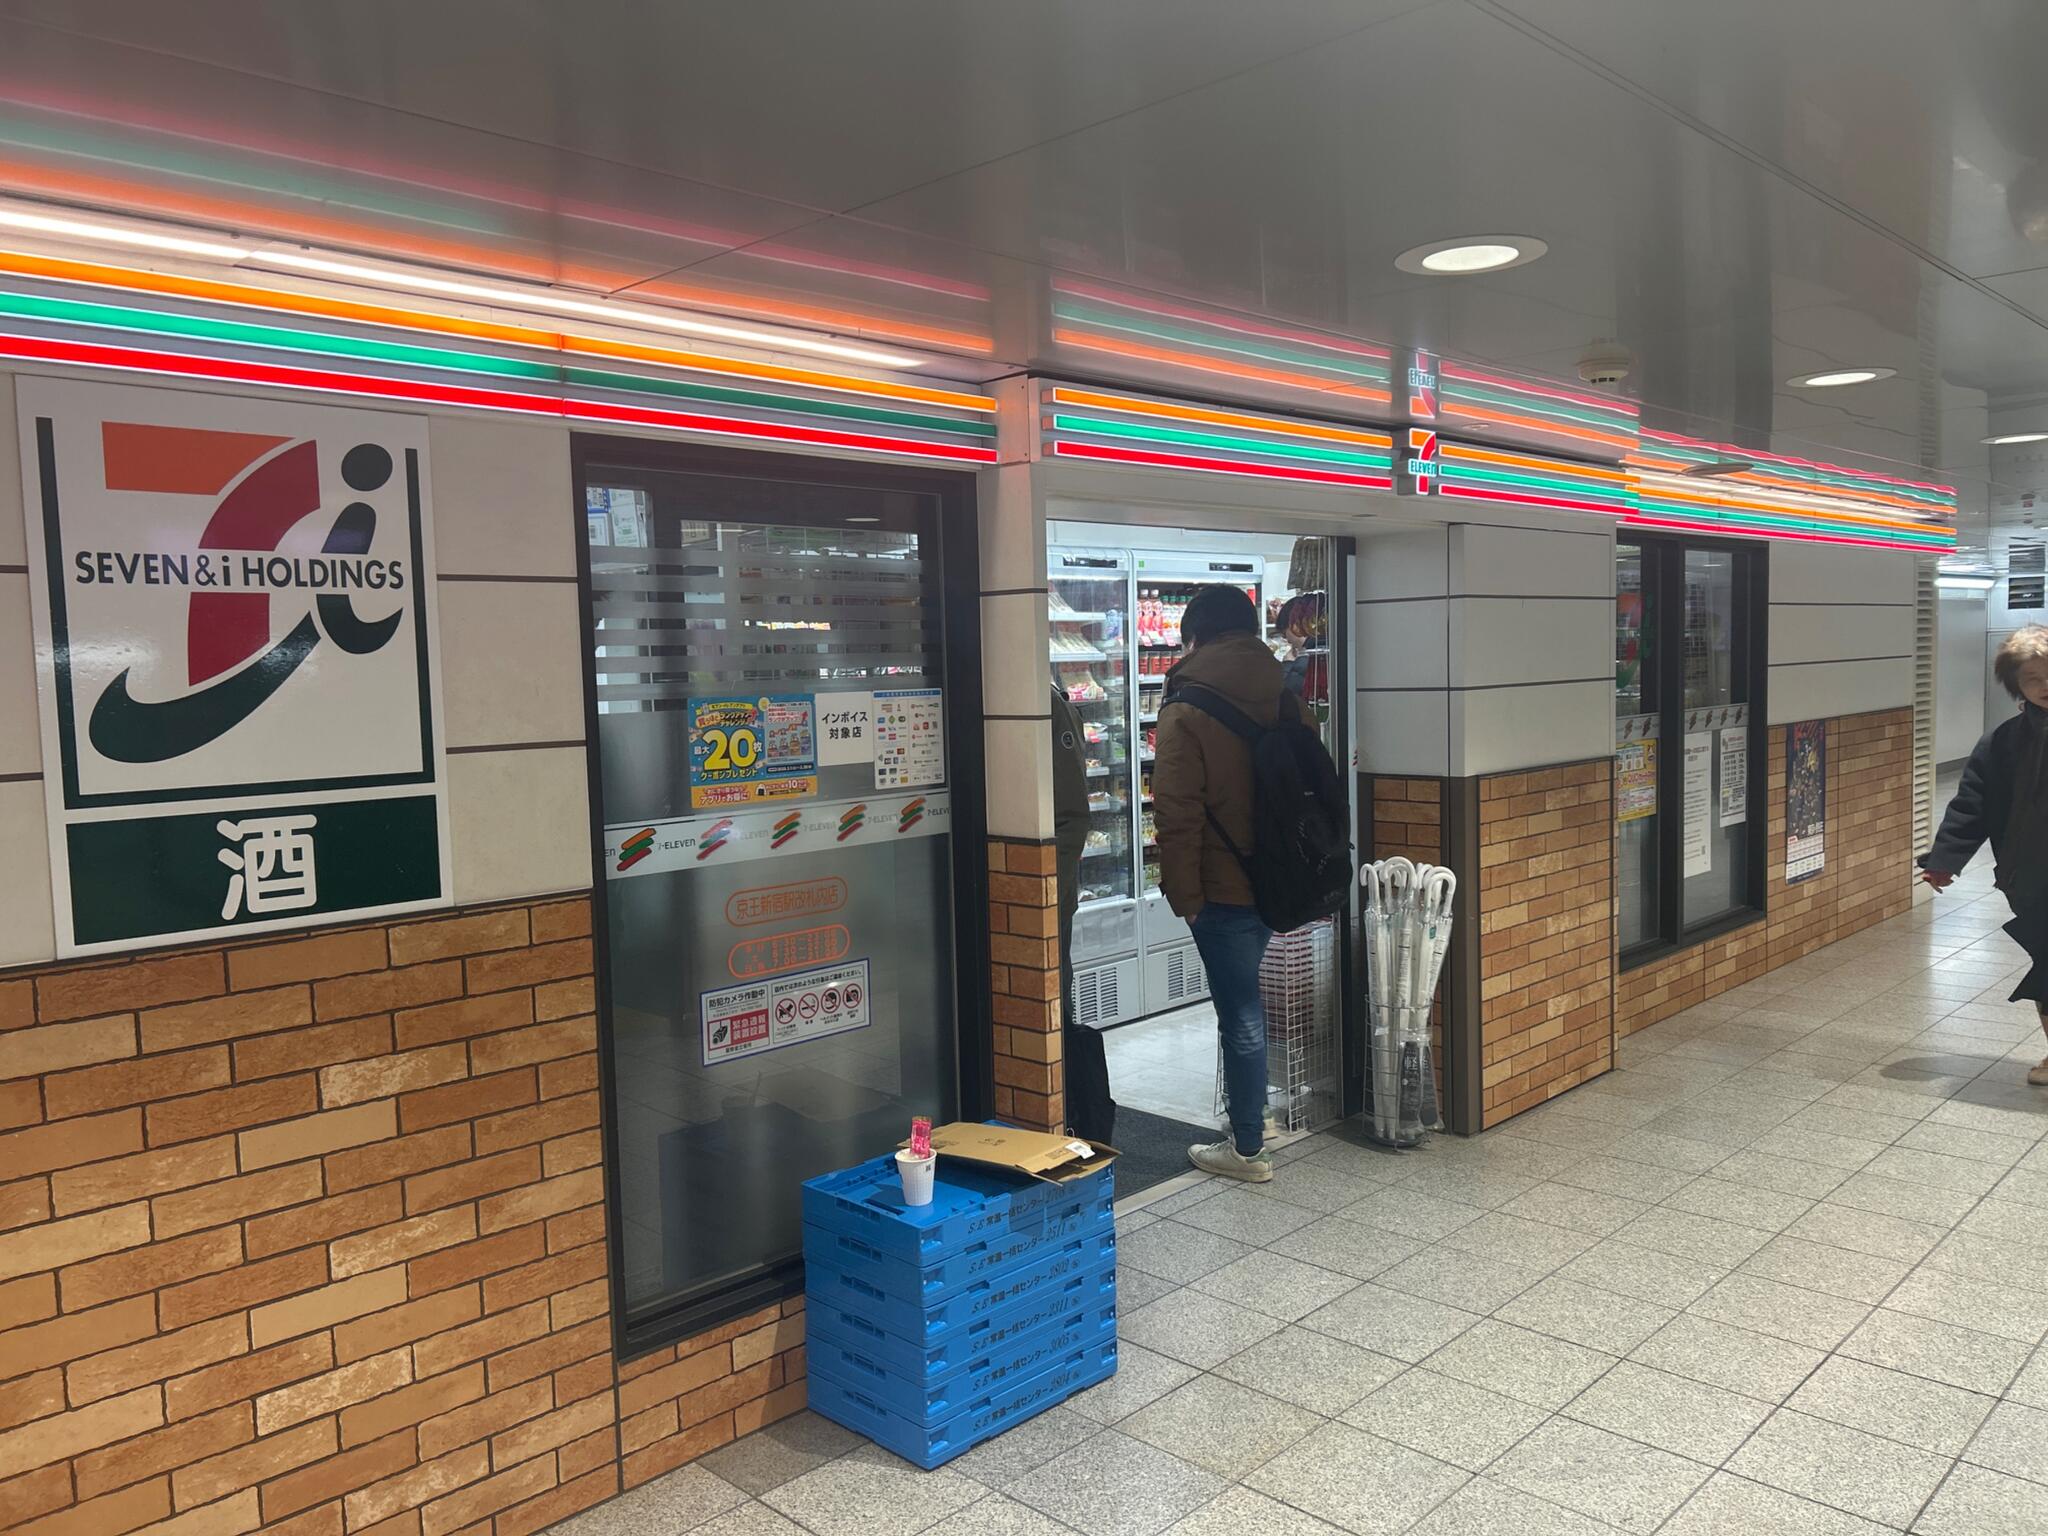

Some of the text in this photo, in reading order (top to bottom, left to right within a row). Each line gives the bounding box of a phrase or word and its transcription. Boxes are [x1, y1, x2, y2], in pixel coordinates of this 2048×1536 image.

[242, 556, 405, 590] HOLDINGS
[821, 711, 869, 725] インボイス
[829, 726, 862, 740] 対象店
[702, 728, 757, 771] 20
[753, 741, 763, 753] 枚
[216, 814, 318, 921] 酒
[709, 989, 766, 1008] 防犯カメラ作動中
